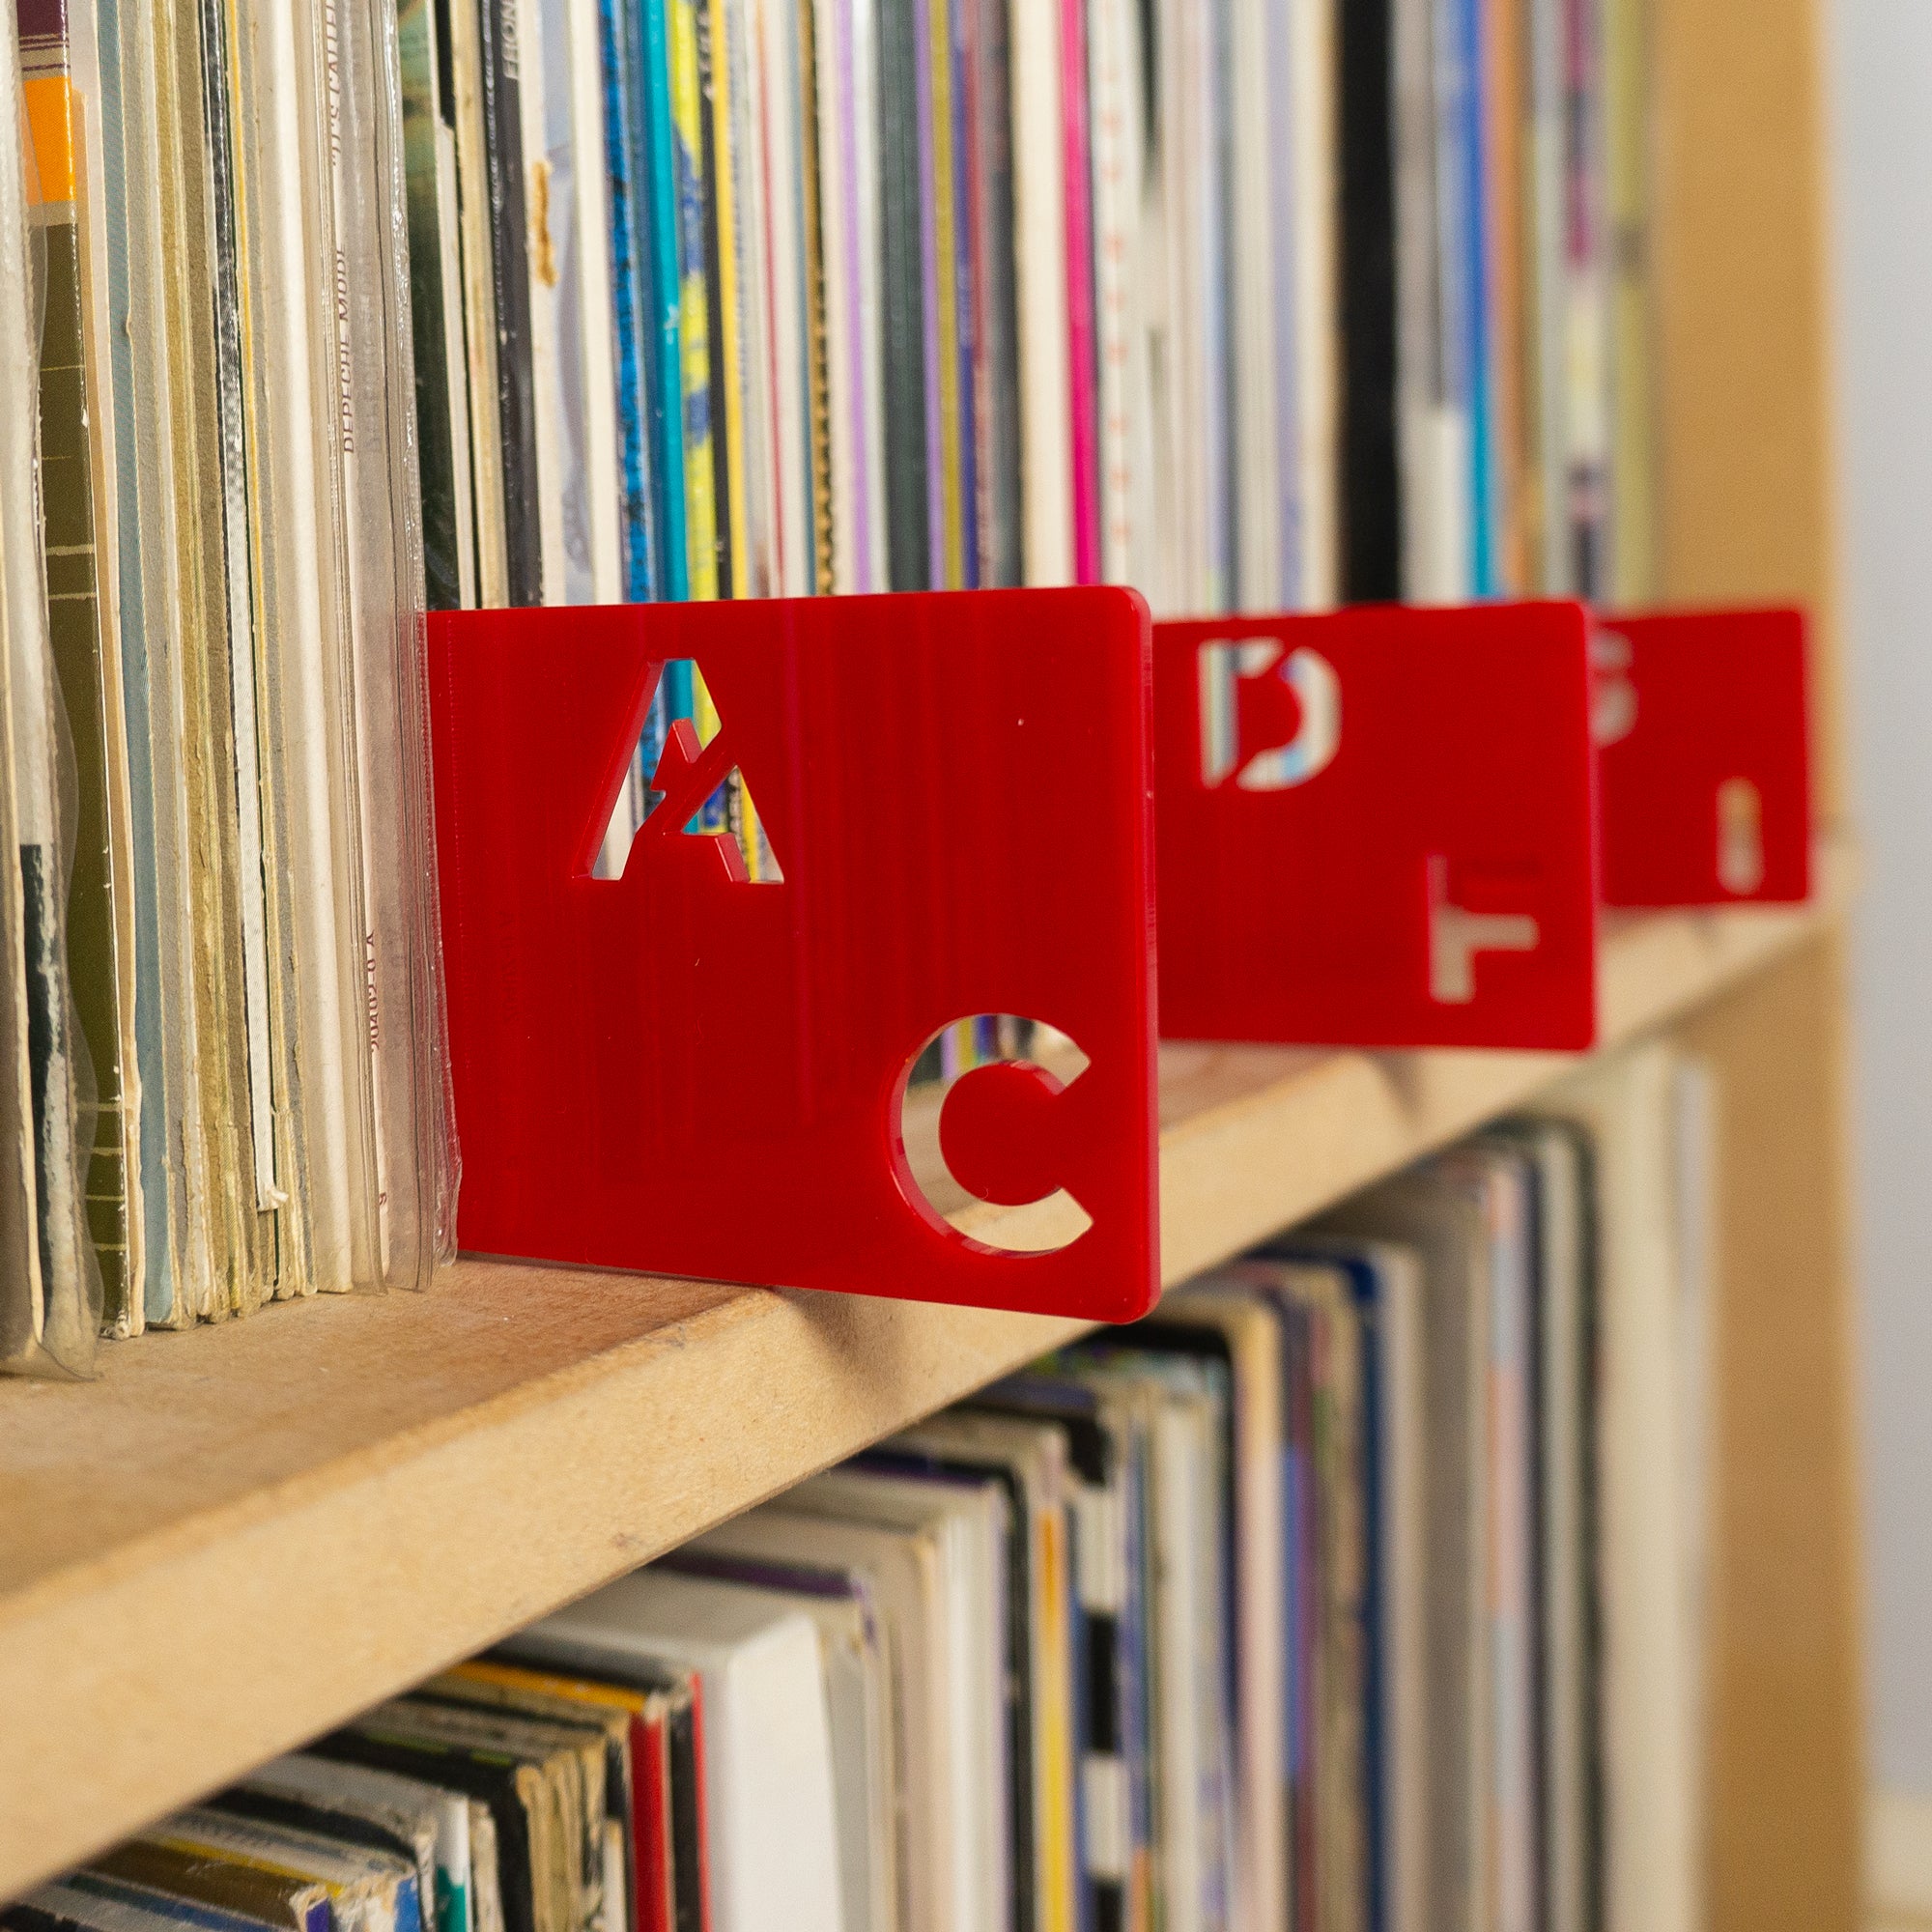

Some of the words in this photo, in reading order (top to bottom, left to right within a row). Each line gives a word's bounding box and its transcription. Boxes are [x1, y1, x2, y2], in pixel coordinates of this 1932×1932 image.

[335, 242, 349, 323] MODE
[340, 334, 355, 454] DEPECHE
[582, 658, 784, 884] A
[1199, 636, 1343, 792] D
[890, 1012, 1094, 1257] C
